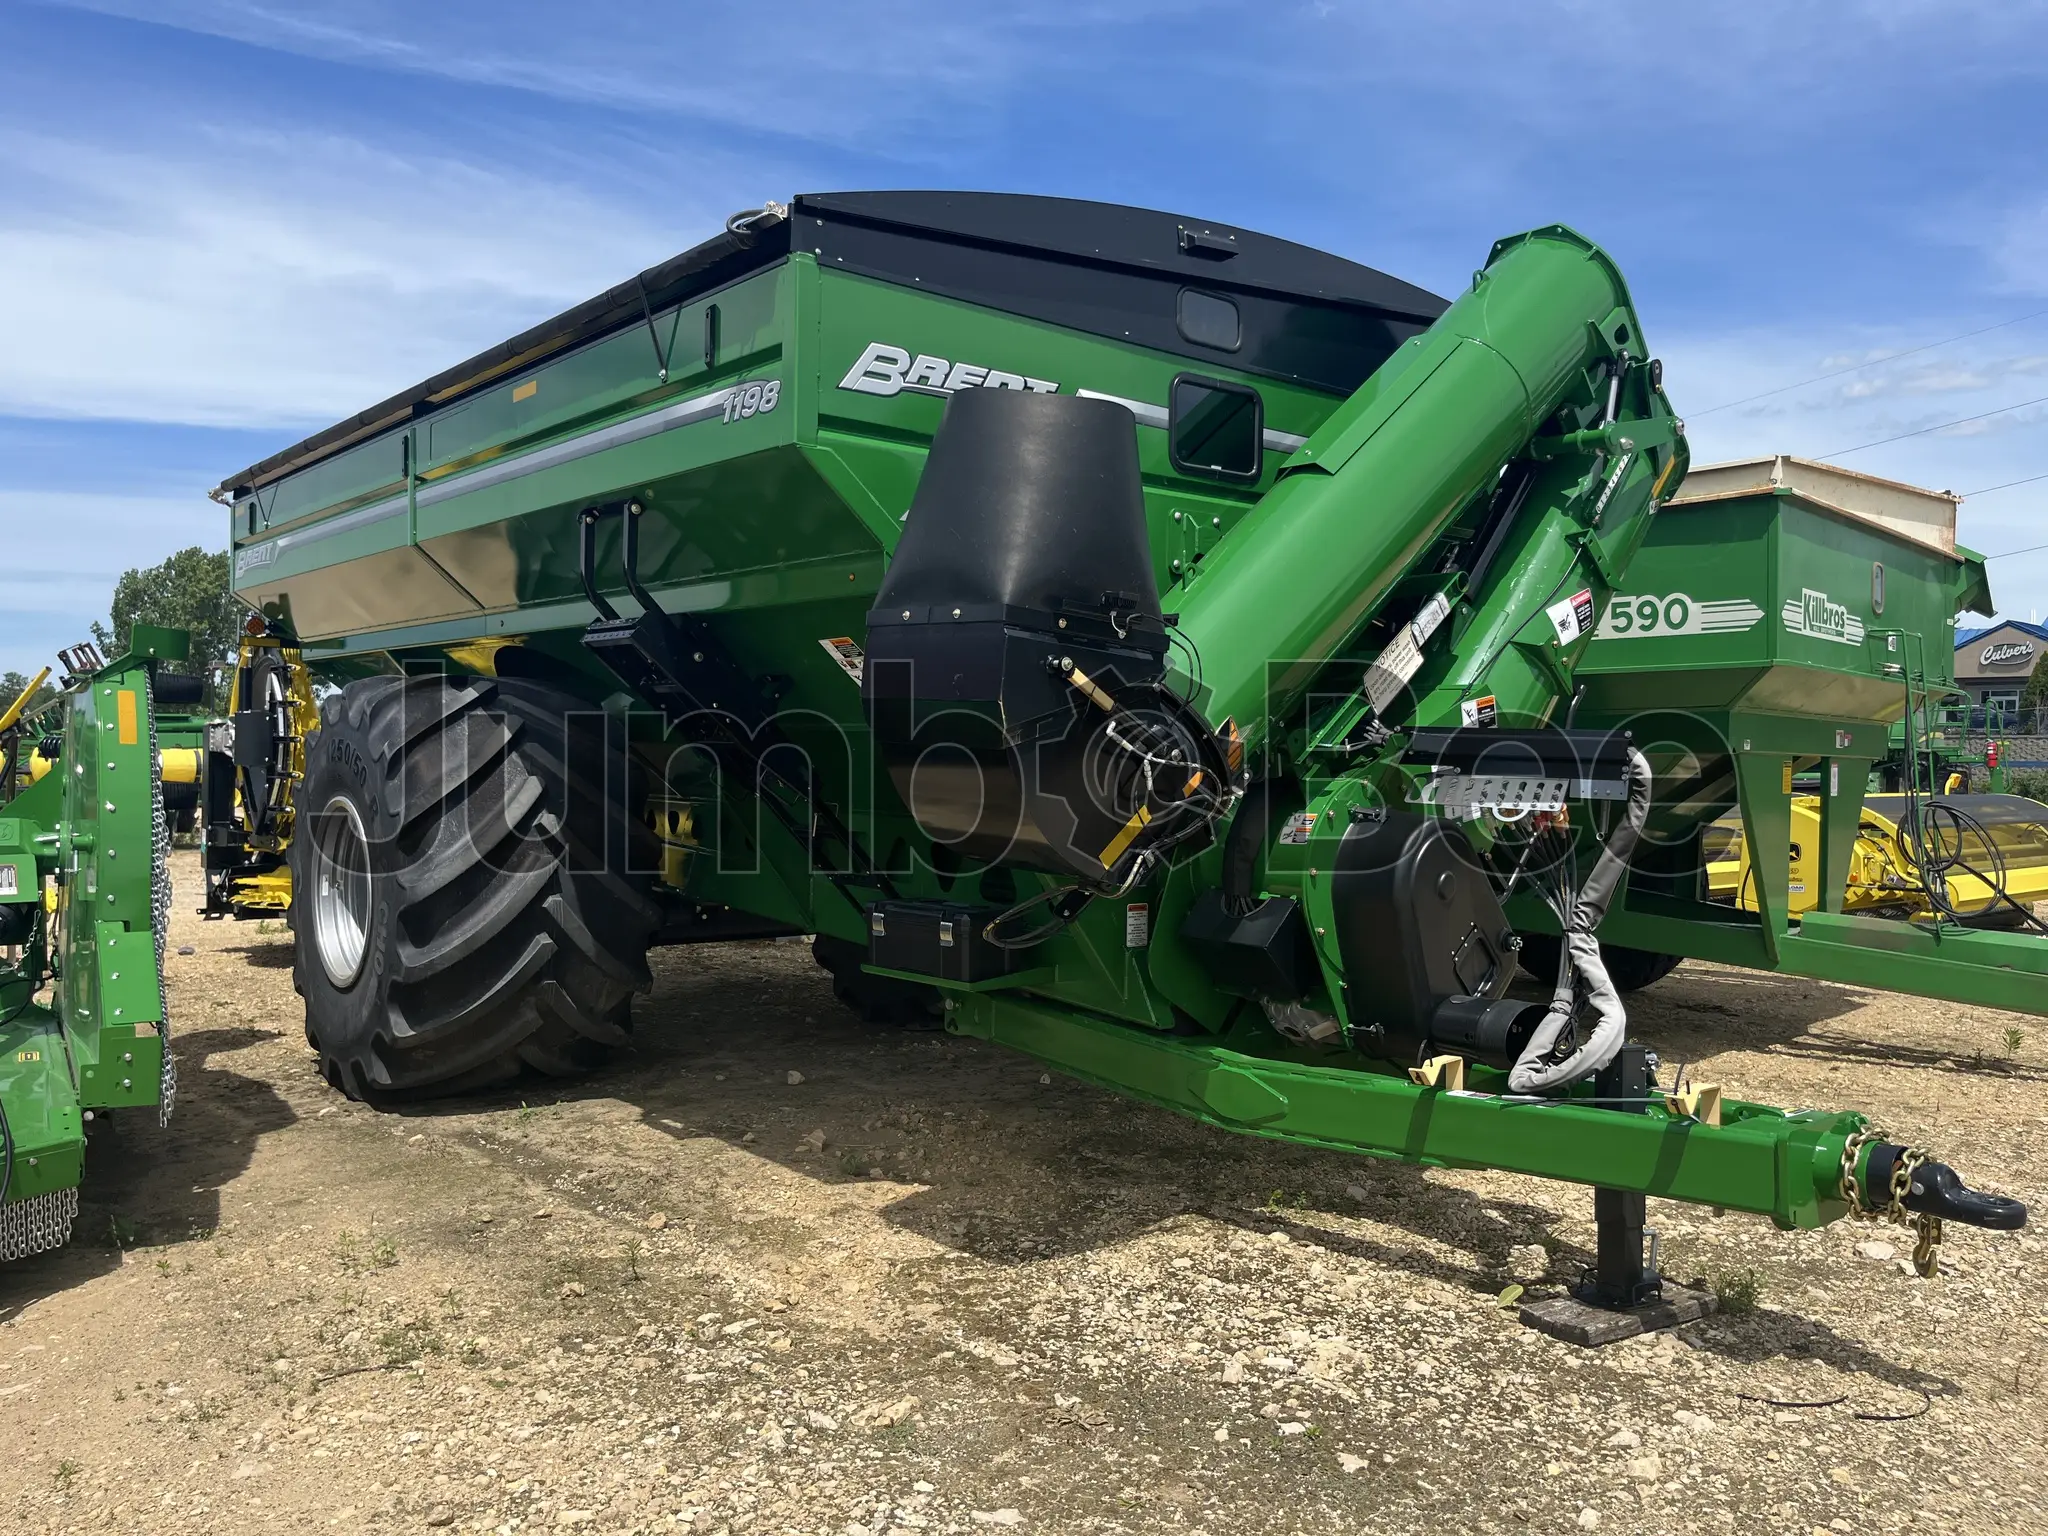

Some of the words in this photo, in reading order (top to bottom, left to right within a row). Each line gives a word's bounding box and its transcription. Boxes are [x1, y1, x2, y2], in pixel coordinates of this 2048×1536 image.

[723, 380, 781, 424] 1198
[1610, 598, 1689, 633] 590
[1803, 593, 1845, 631] Killbros
[1375, 638, 1400, 672] NOTICE
[1980, 641, 2035, 665] Culver's
